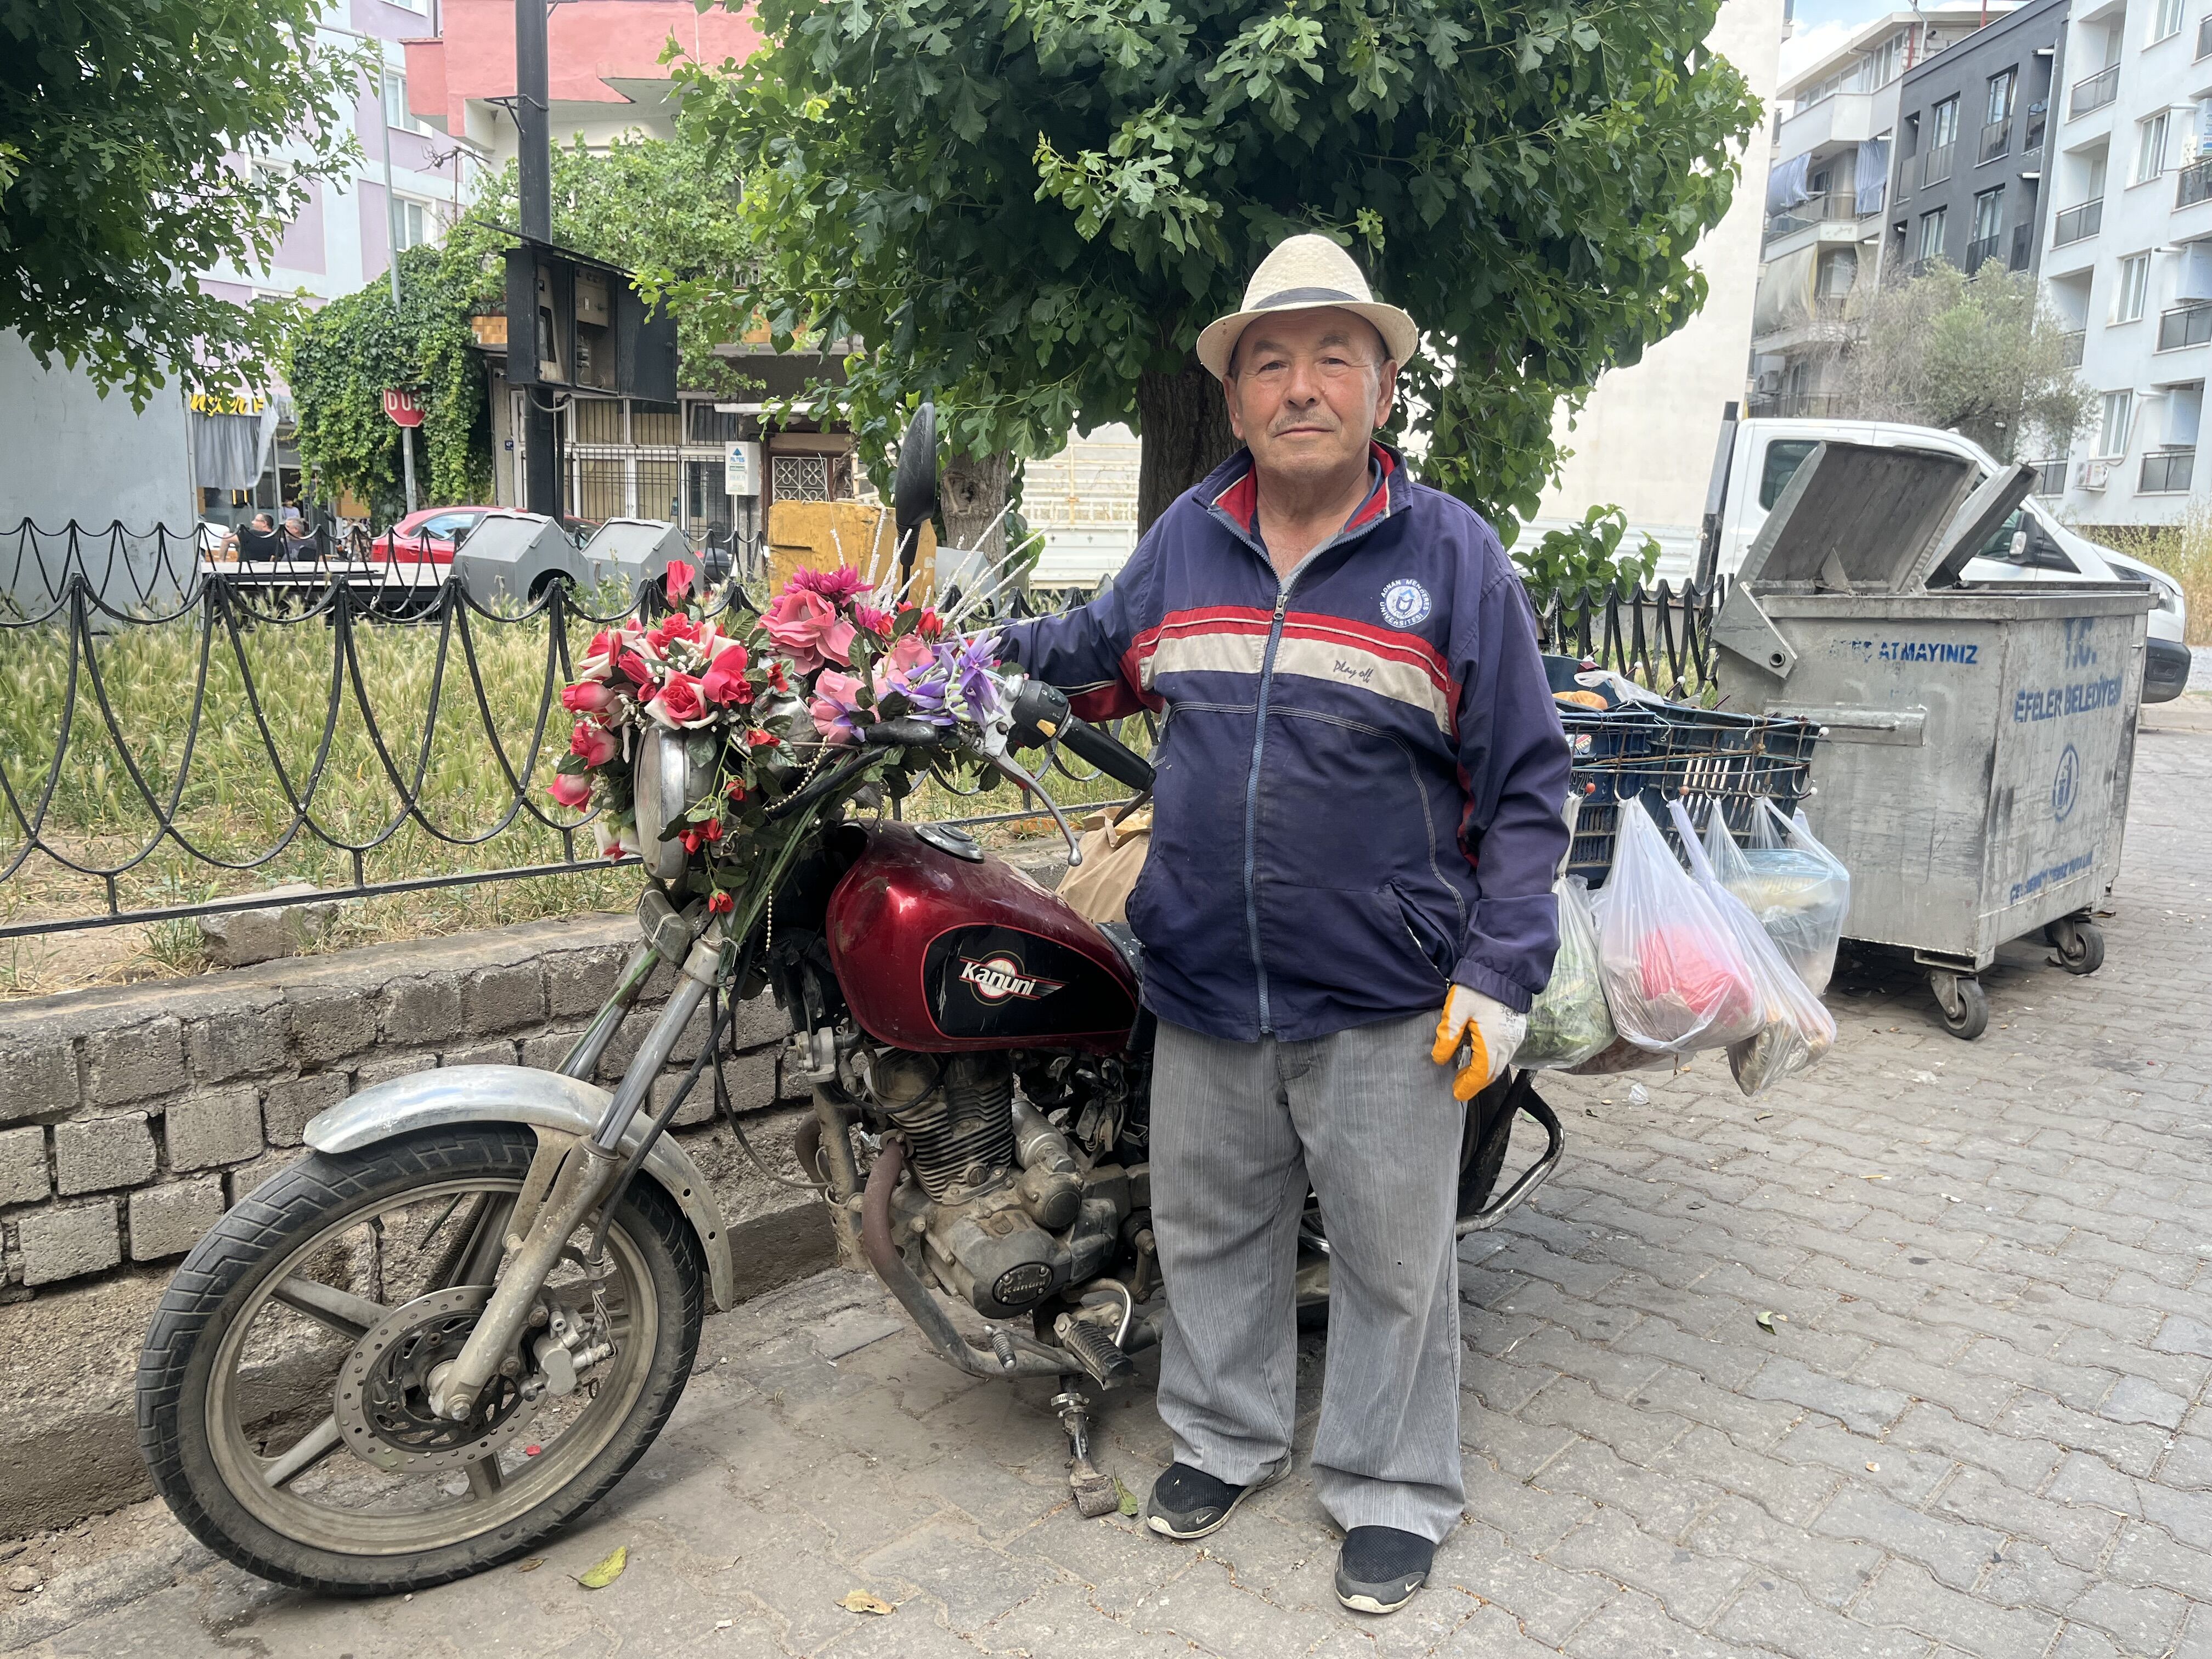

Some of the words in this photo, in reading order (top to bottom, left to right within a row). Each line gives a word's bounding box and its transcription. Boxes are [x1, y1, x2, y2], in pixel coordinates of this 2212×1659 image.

[387, 391, 425, 412] DU
[1380, 579, 1401, 598] ADNAN
[1406, 579, 1430, 611] MENDERES
[1878, 641, 1978, 664] ATMAYINIZ
[1333, 660, 1357, 679] Play
[1359, 668, 1374, 683] off
[2014, 687, 2063, 723] EFELER
[961, 962, 1036, 995] Kanuni
